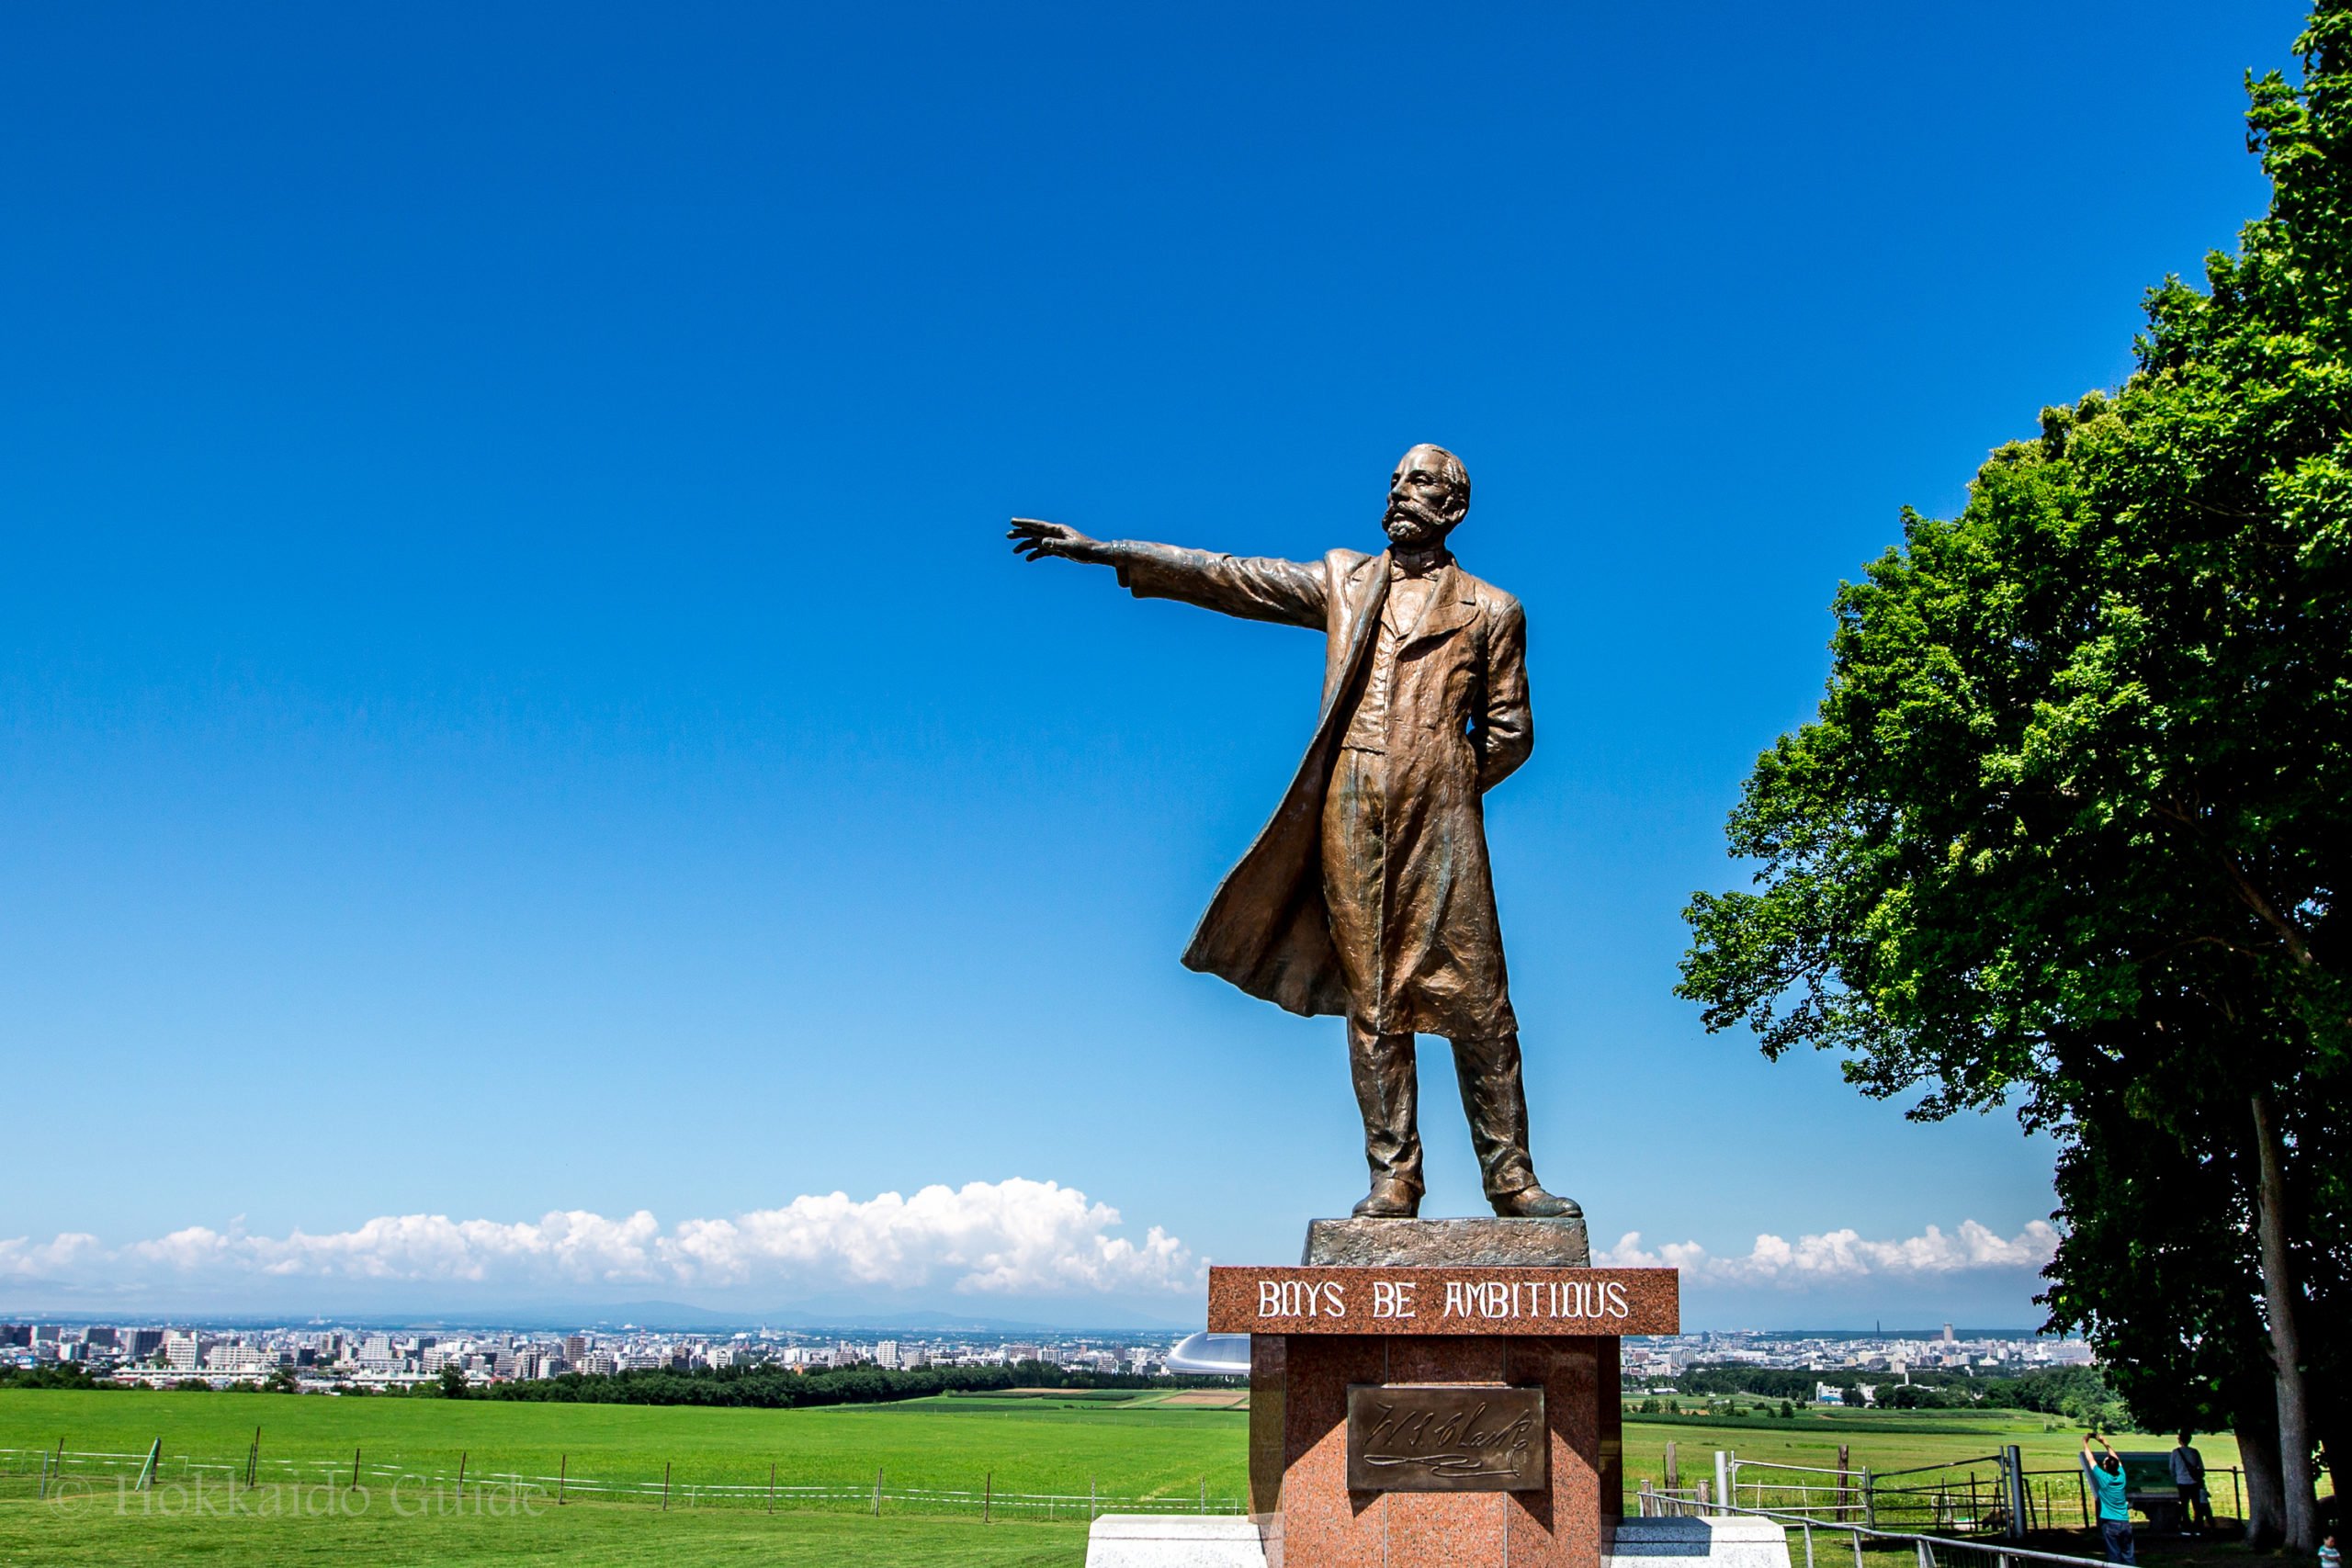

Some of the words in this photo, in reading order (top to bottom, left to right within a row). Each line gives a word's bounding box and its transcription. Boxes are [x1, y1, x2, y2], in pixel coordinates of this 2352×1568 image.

[1258, 1280, 1346, 1317] BOYS
[1373, 1281, 1417, 1317] BE
[1443, 1281, 1629, 1318] AMBITIOUS
